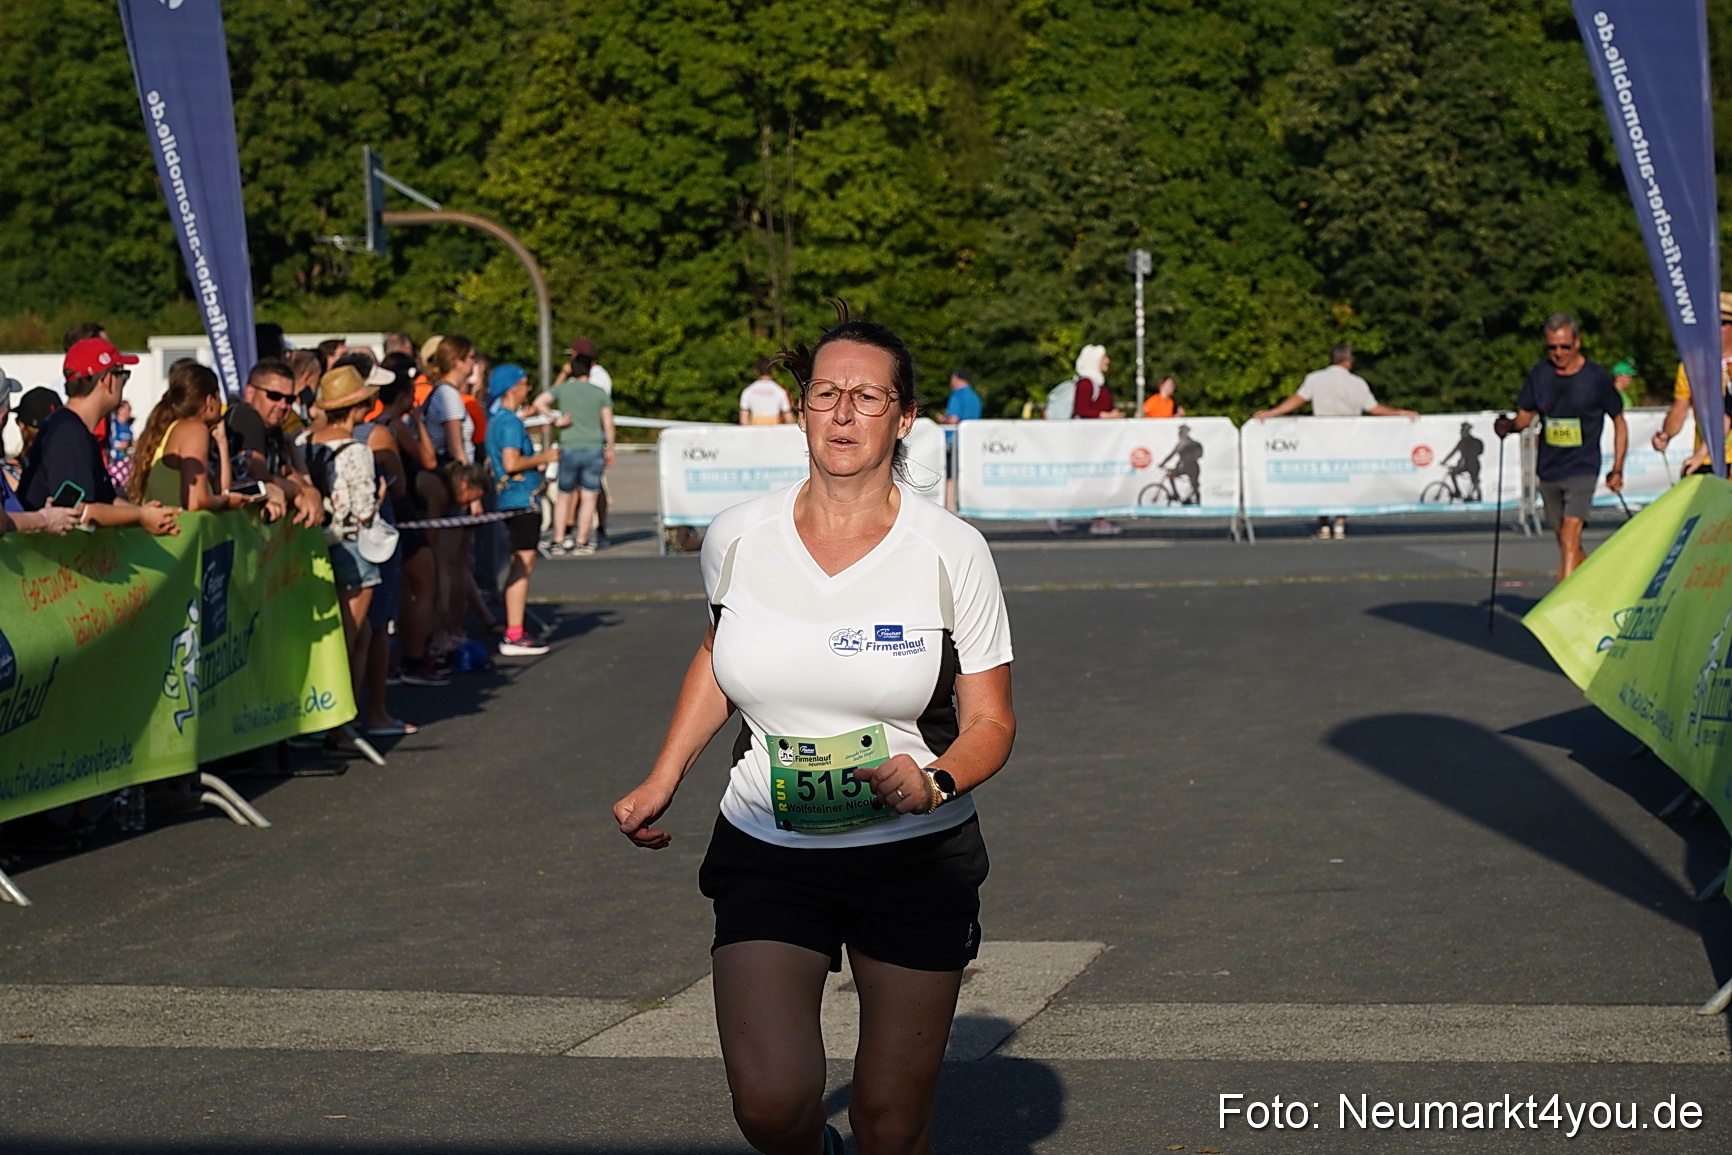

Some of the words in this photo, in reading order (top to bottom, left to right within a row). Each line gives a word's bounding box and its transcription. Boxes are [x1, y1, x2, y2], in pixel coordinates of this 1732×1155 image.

[982, 442, 1018, 455] NOW
[1265, 439, 1300, 453] NOW
[682, 447, 719, 461] NOW
[865, 637, 925, 652] Firmenlauf
[892, 646, 927, 657] neumarkt
[795, 754, 832, 763] Firmenlauf
[797, 766, 876, 802] 515
[775, 779, 789, 812] RUN
[787, 803, 844, 814] Wolfsteiner
